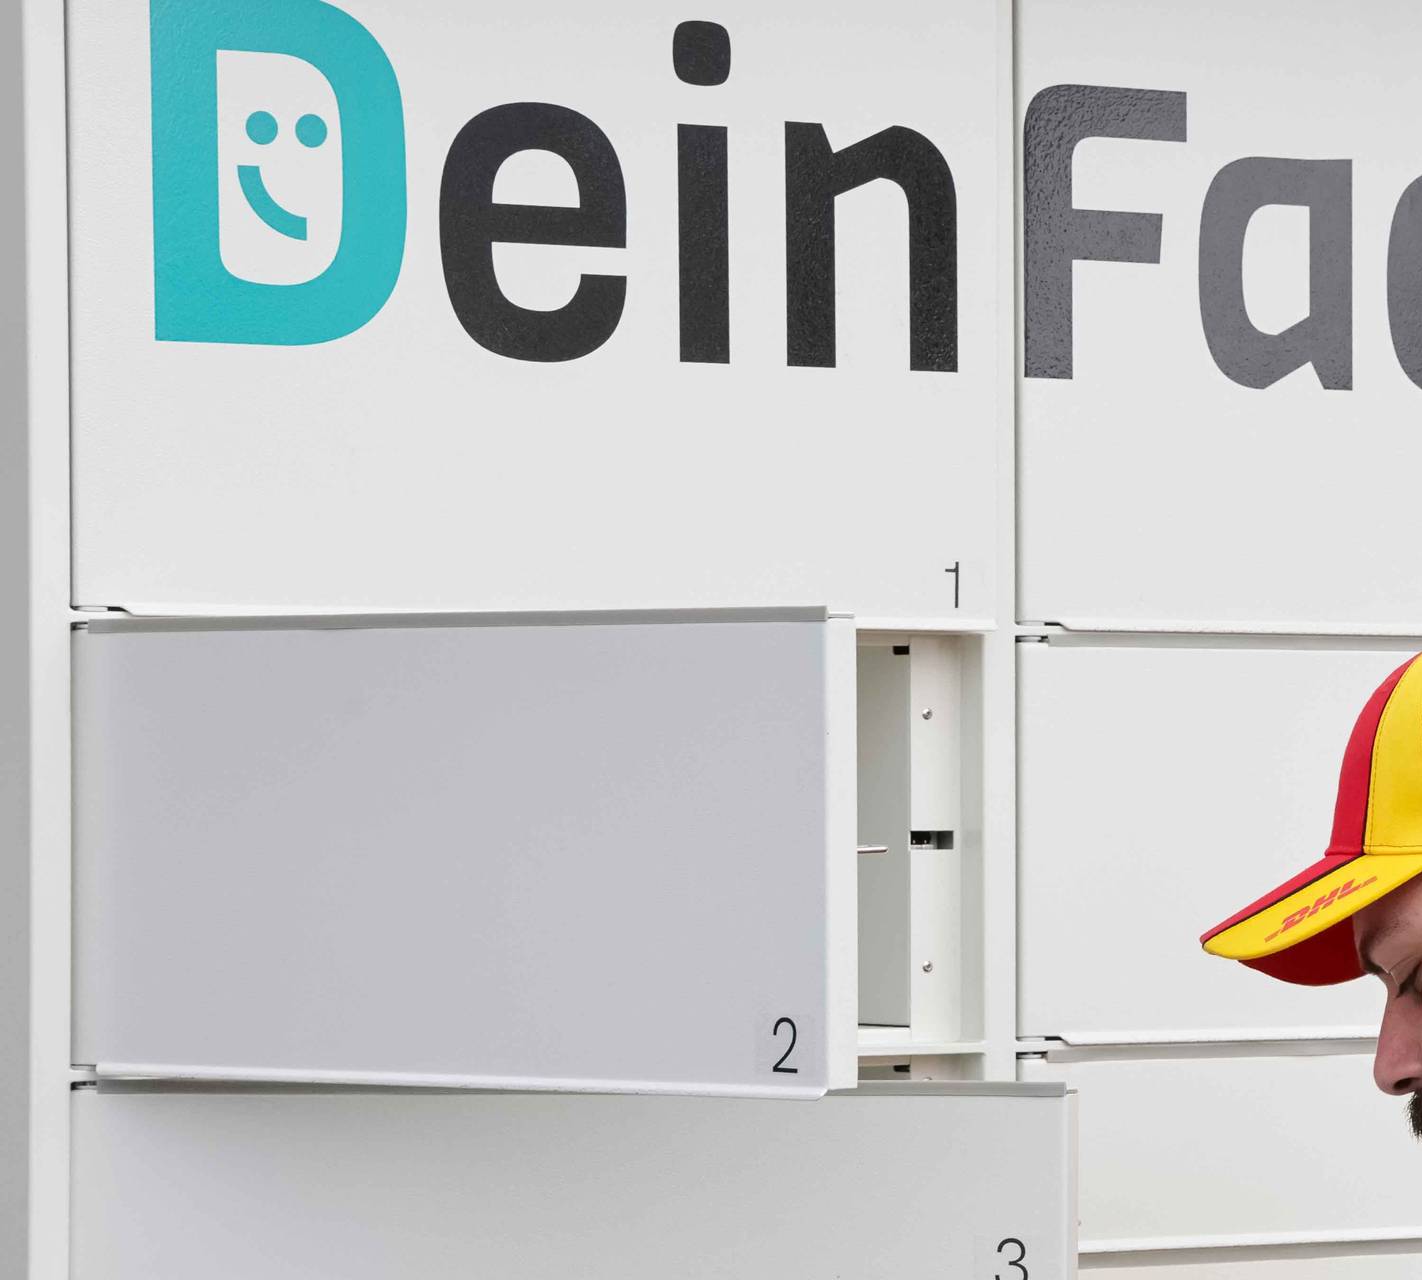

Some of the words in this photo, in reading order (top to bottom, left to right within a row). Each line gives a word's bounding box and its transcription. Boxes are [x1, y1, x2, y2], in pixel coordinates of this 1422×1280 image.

[944, 561, 960, 609] 1
[1278, 878, 1365, 934] DHL
[772, 1016, 799, 1074] 2
[994, 1237, 1029, 1280] 3
